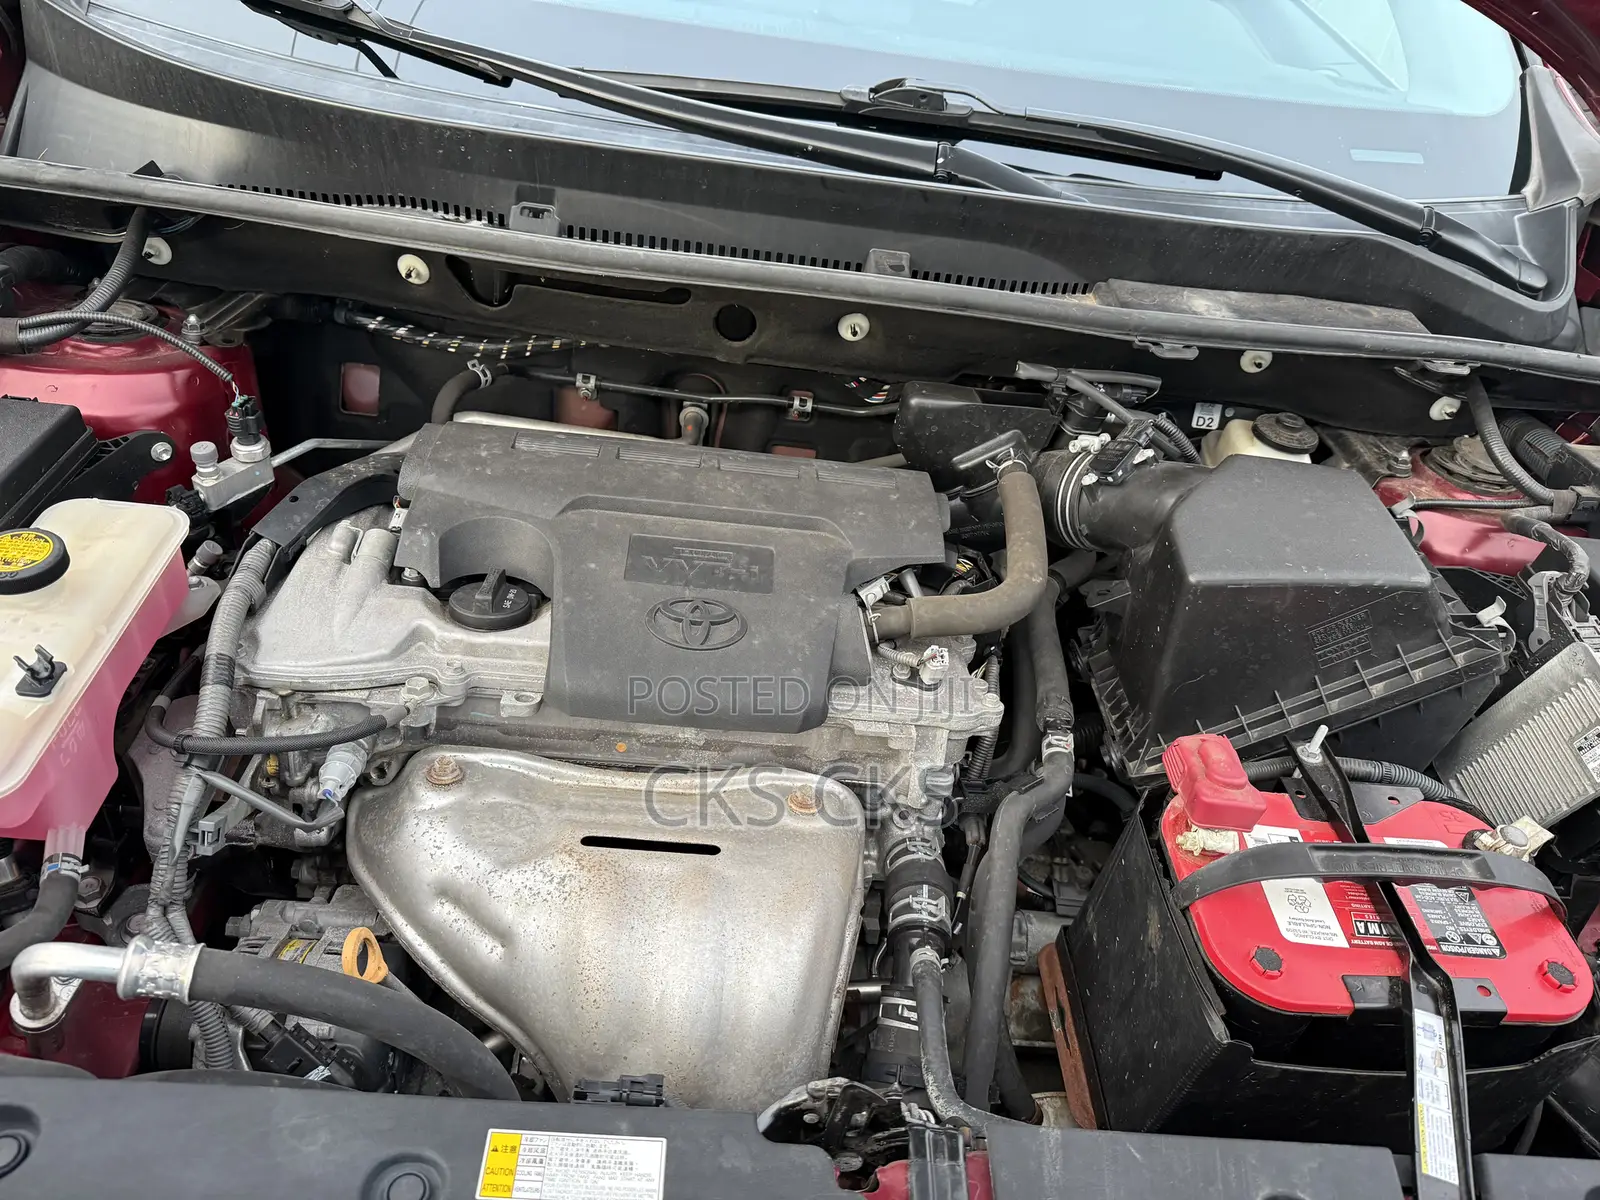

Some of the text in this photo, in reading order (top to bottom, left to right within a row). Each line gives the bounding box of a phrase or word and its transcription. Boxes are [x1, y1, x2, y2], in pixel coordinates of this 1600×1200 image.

[1195, 416, 1214, 428] D2
[501, 1144, 518, 1154] 注意
[486, 1166, 514, 1177] CAUTION
[482, 1183, 511, 1193] ATTENTION
